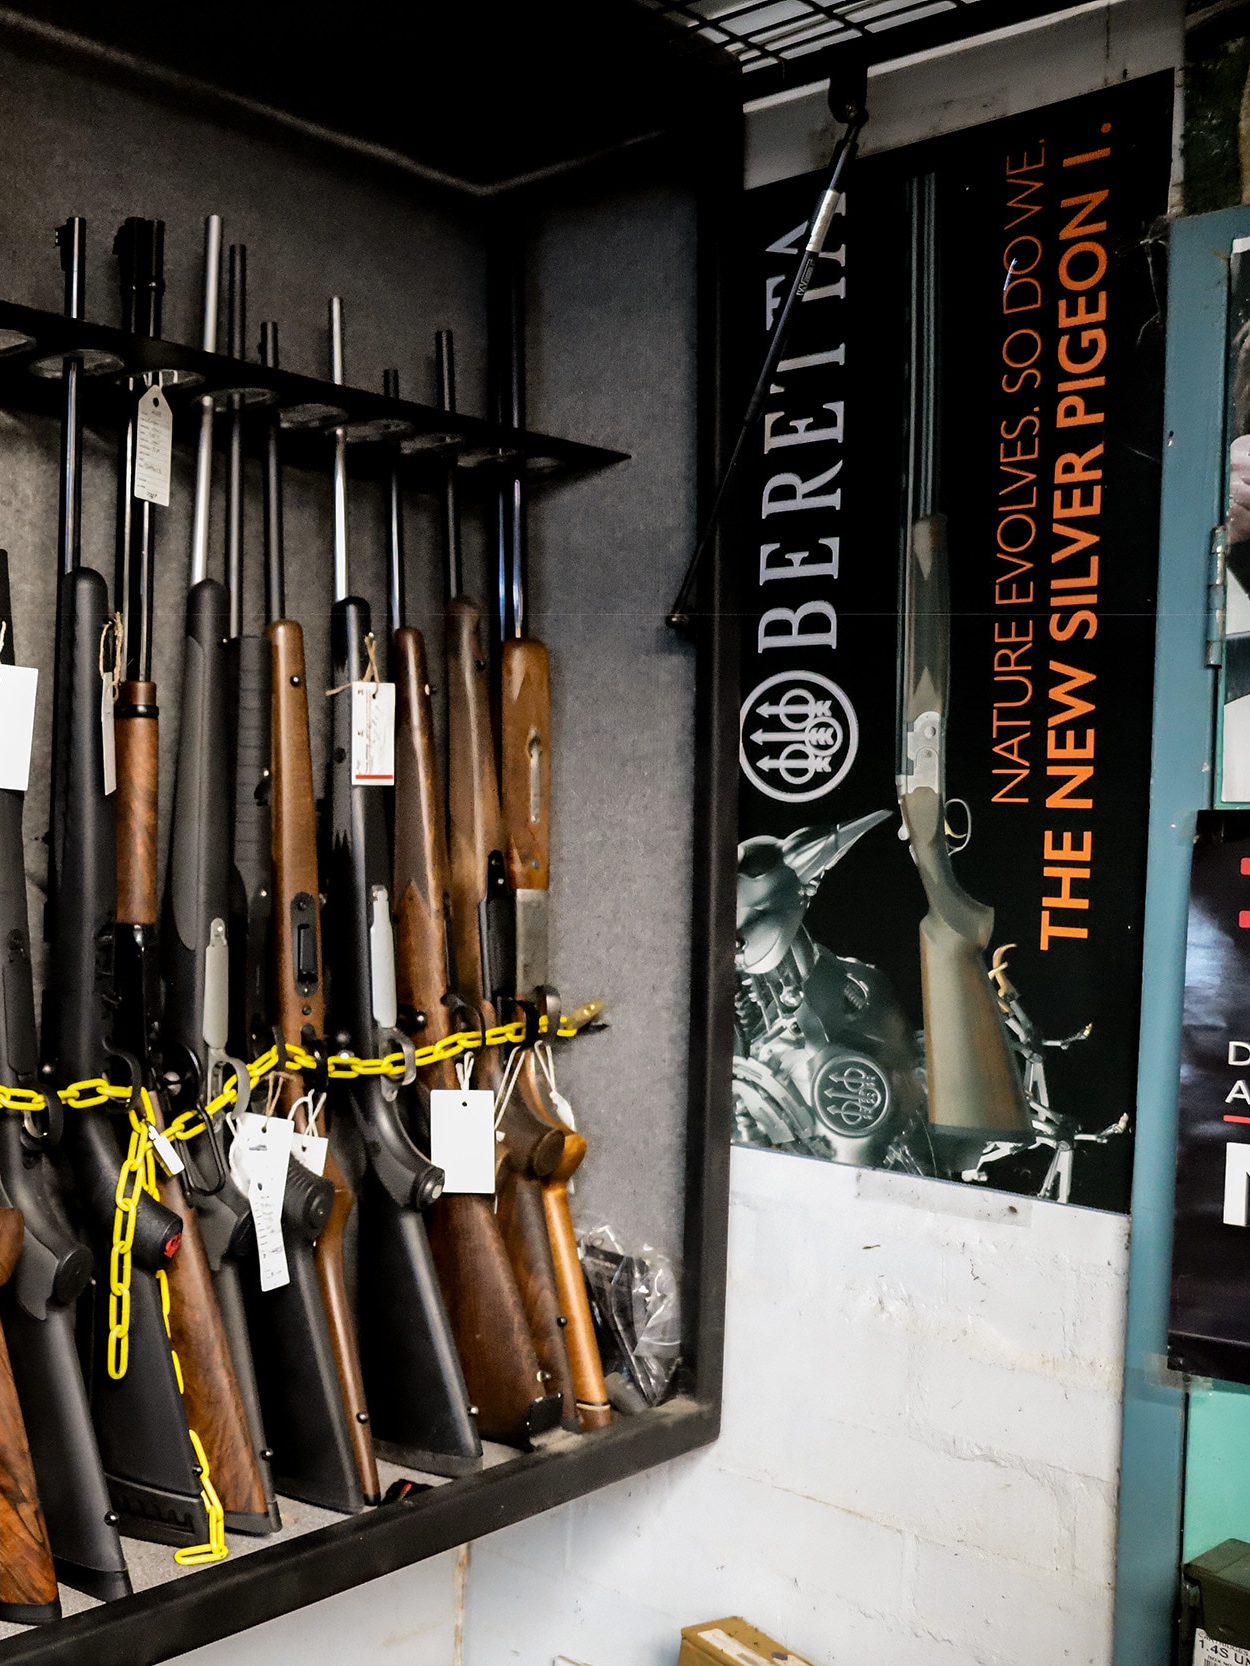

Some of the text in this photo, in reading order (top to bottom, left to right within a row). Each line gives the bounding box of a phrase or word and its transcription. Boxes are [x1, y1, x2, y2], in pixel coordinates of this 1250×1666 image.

[1057, 189, 1110, 428] PIGEON
[992, 138, 1047, 803] NATURE EVOLVES. SO DO WE.
[1048, 444, 1105, 642] SILVER
[1046, 659, 1098, 809] NEW
[1040, 830, 1093, 951] THE
[1199, 1639, 1229, 1659] 1.4S
